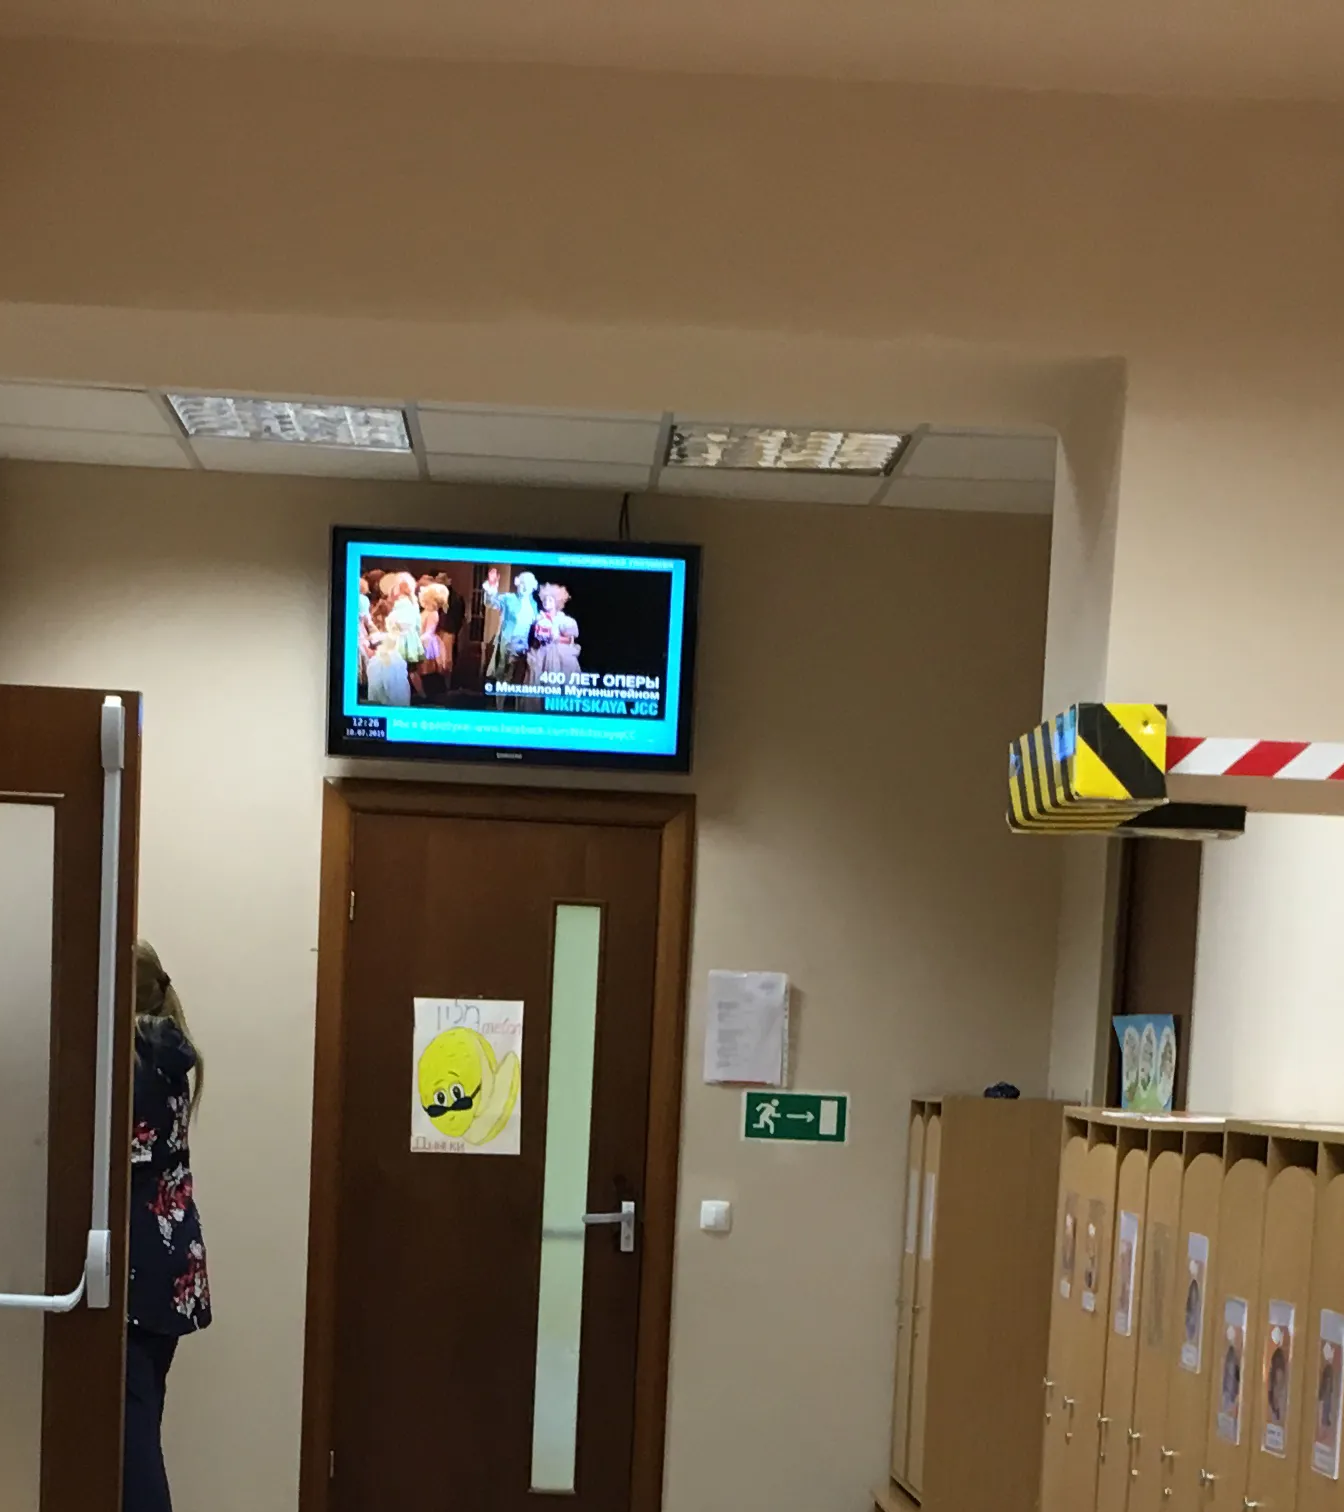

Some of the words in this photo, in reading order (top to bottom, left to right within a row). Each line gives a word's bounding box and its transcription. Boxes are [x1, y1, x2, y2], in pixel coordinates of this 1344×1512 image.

[495, 681, 562, 696] Михаилом
[539, 671, 565, 685] 400
[568, 672, 600, 687] ЛЕТ
[602, 674, 660, 690] ОПЕРЫ
[544, 696, 628, 715] NIKITSKAYA
[629, 701, 659, 717] JCC
